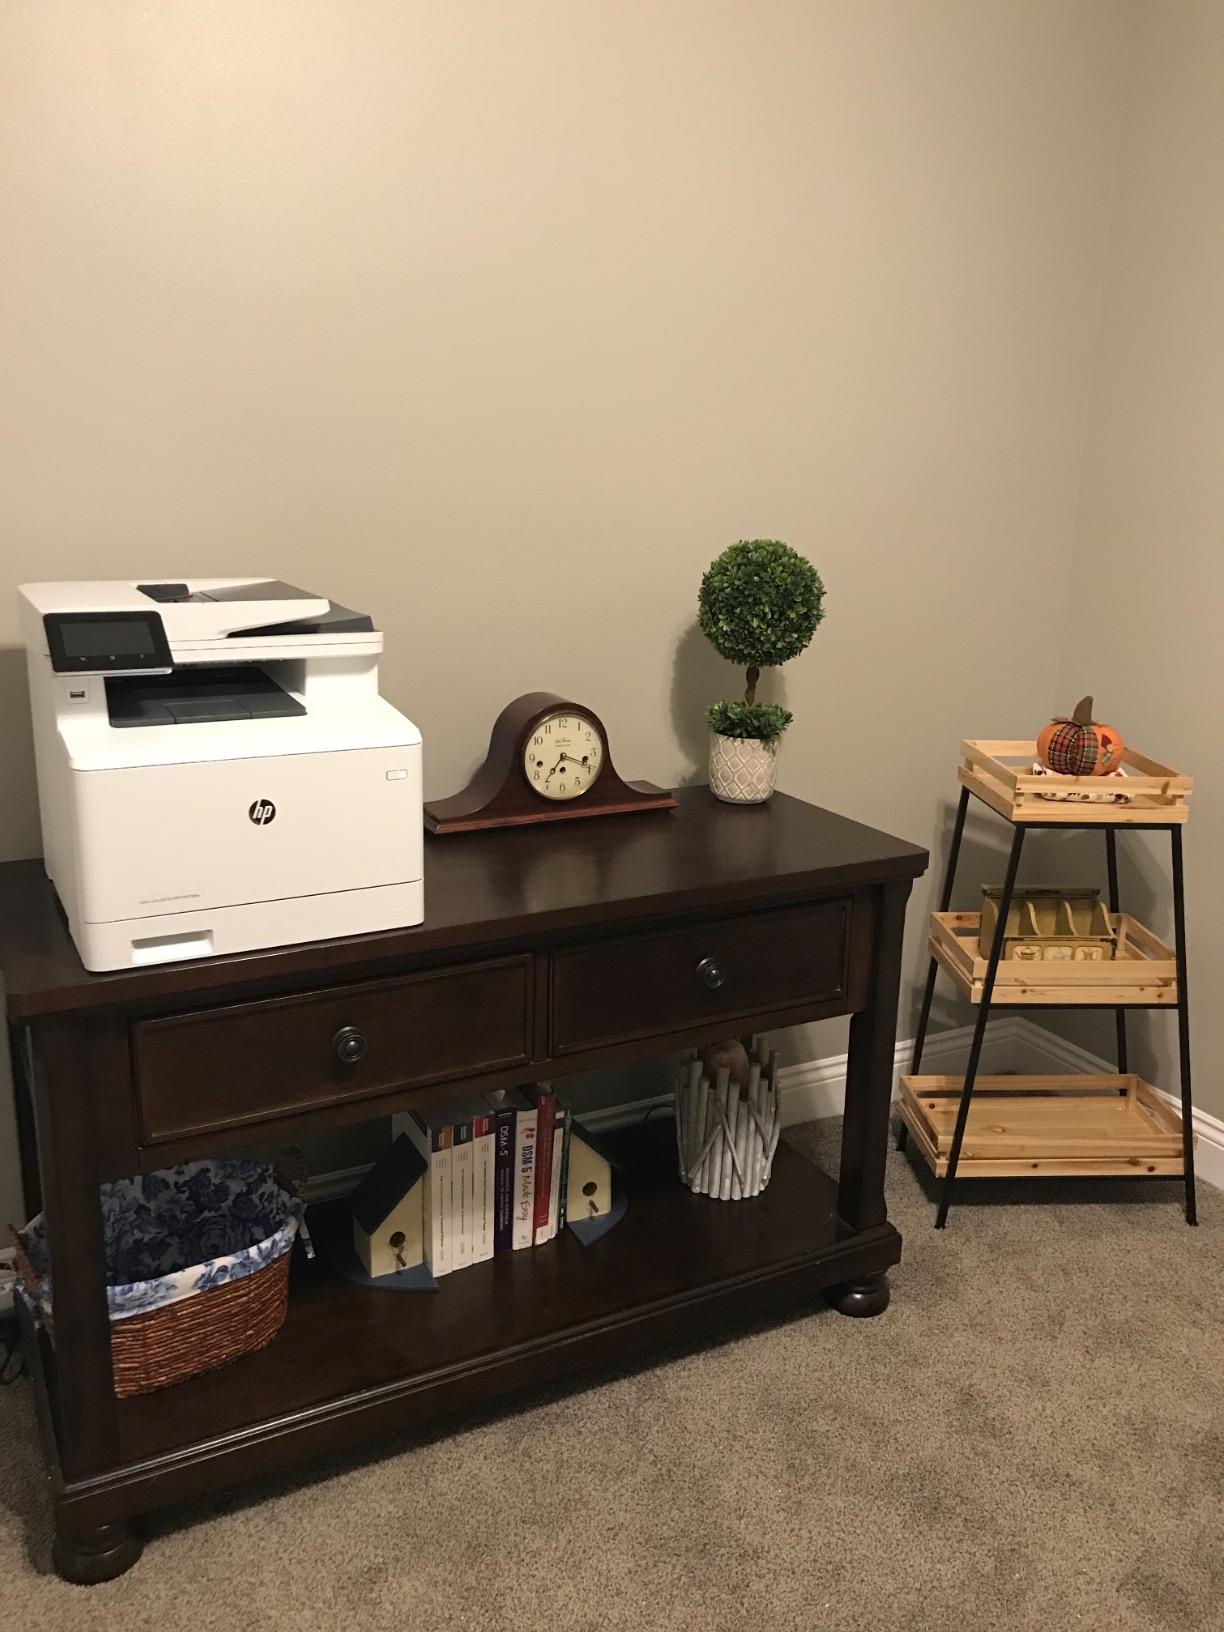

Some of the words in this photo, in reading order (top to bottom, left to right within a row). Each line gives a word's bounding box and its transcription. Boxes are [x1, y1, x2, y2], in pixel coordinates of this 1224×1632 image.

[558, 718, 568, 728] 12
[545, 724, 551, 734] 11
[534, 736, 543, 746] 10
[585, 732, 591, 741] 2
[590, 747, 597, 757] 3
[529, 753, 535, 763] 9
[533, 770, 540, 780] 8
[574, 777, 581, 786] 5
[559, 783, 565, 792] 6
[252, 800, 273, 825] hp
[500, 1125, 509, 1156] DSM-5
[521, 1144, 534, 1173] DSM-5
[521, 1174, 532, 1199] Made
[517, 1201, 531, 1222] Easy
